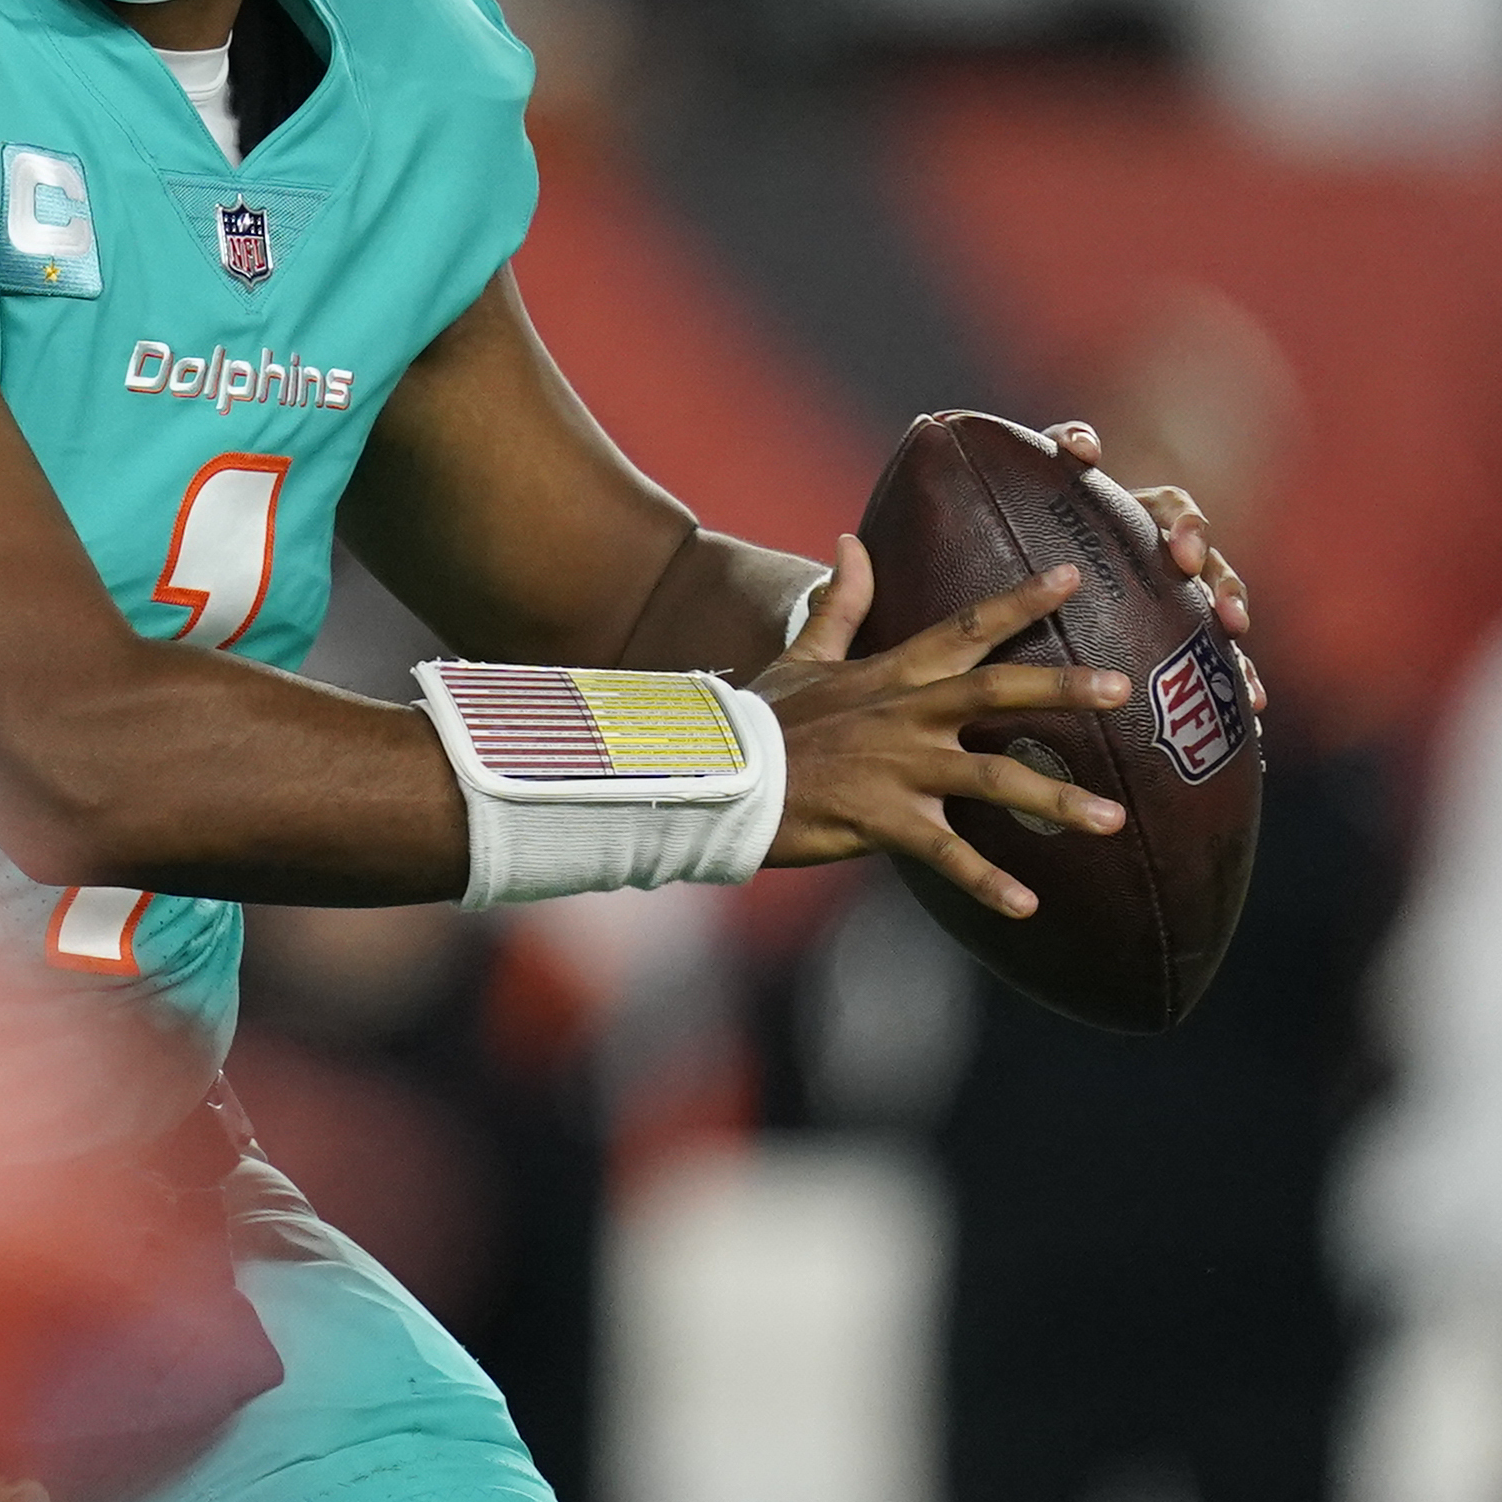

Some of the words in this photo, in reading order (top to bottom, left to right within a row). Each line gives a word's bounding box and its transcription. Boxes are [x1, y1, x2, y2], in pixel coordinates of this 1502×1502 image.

[7, 152, 93, 256] C
[228, 237, 268, 273] NFL
[124, 340, 354, 415] Dolphins
[1160, 657, 1224, 773] NFL
